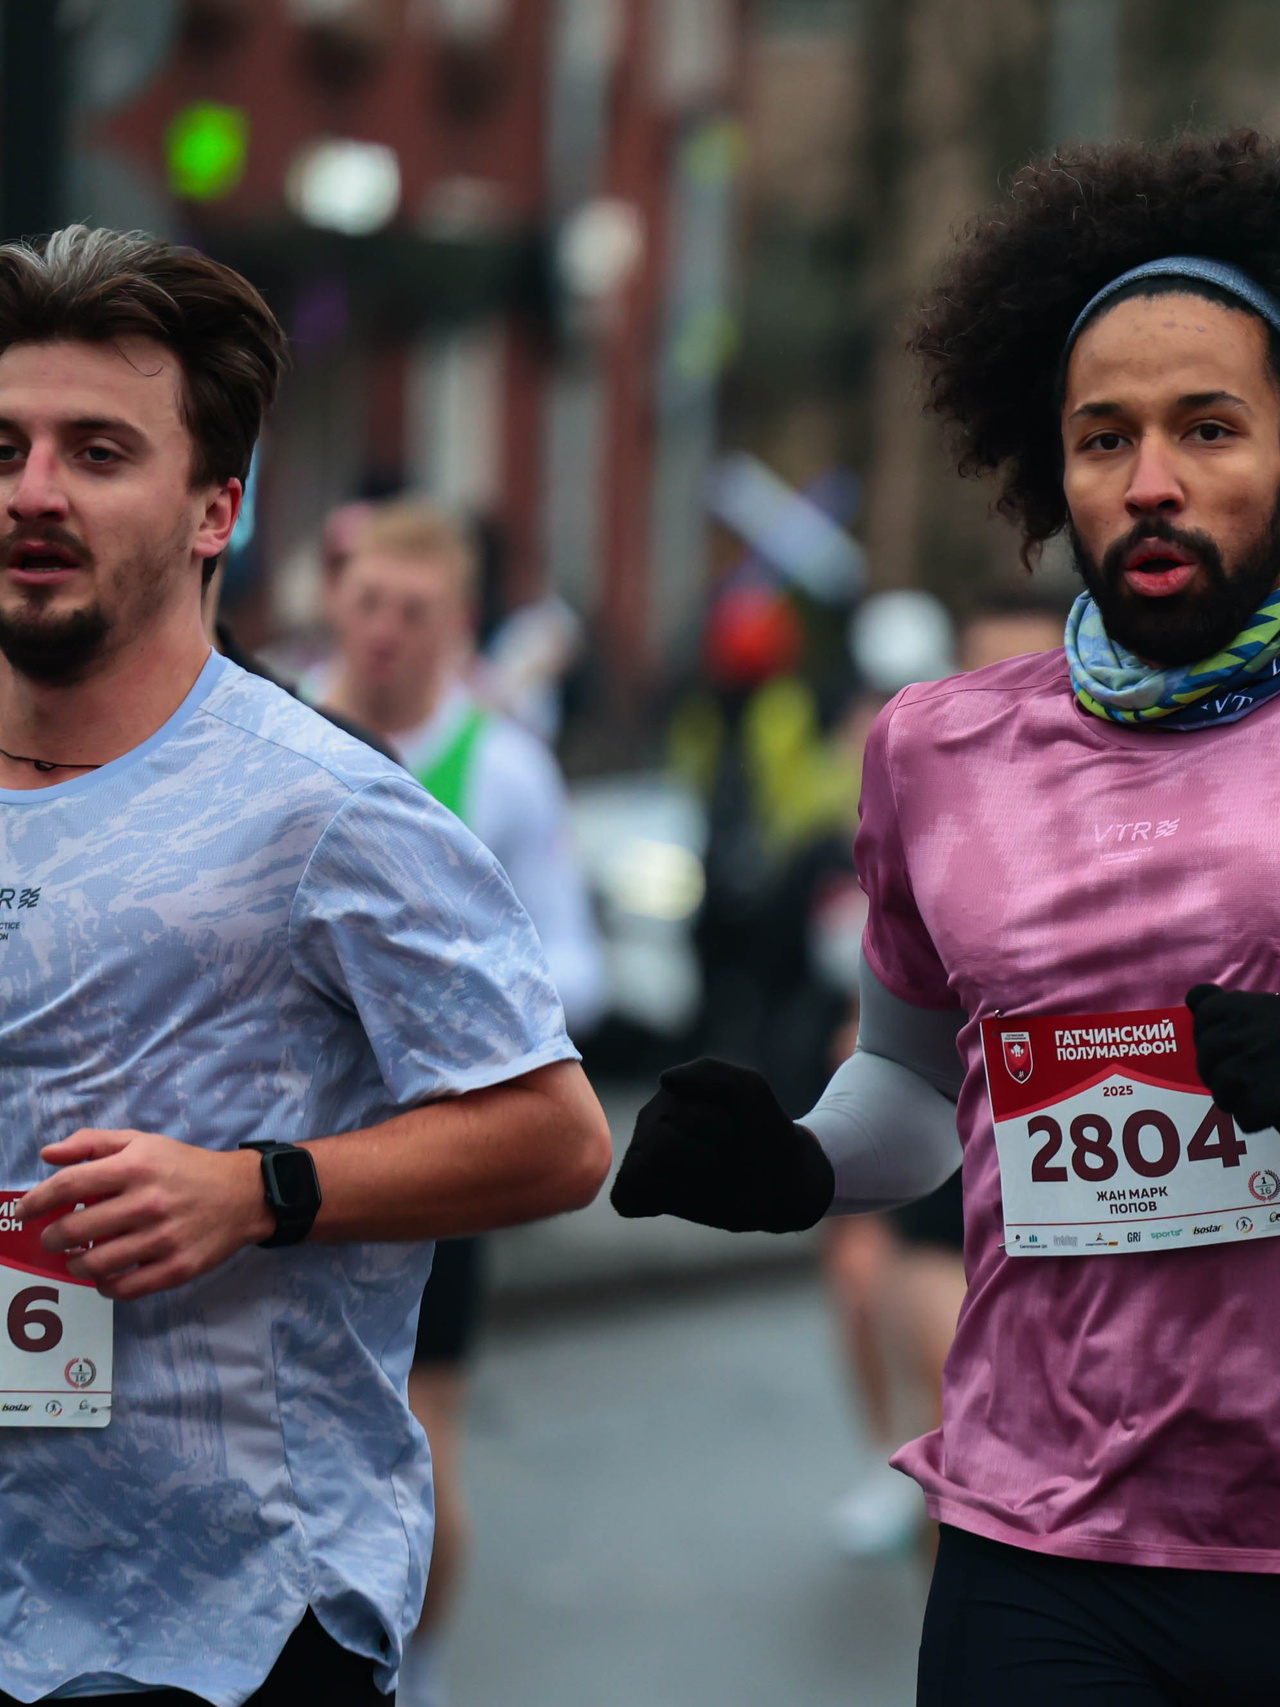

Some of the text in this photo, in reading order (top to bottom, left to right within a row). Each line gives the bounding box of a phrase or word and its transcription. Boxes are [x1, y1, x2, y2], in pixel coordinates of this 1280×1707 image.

[1094, 821, 1152, 843] VTR
[1054, 1019, 1175, 1046] ГАТЧИНСКИЙ
[1056, 1040, 1177, 1061] ПОЛУМАРАФОН
[1102, 1085, 1134, 1097] 2025
[1027, 1102, 1248, 1182] 2804
[1096, 1186, 1169, 1202] ЖАН МАРК
[1110, 1201, 1158, 1215] ПОПОВ
[7, 1285, 63, 1353] 6
